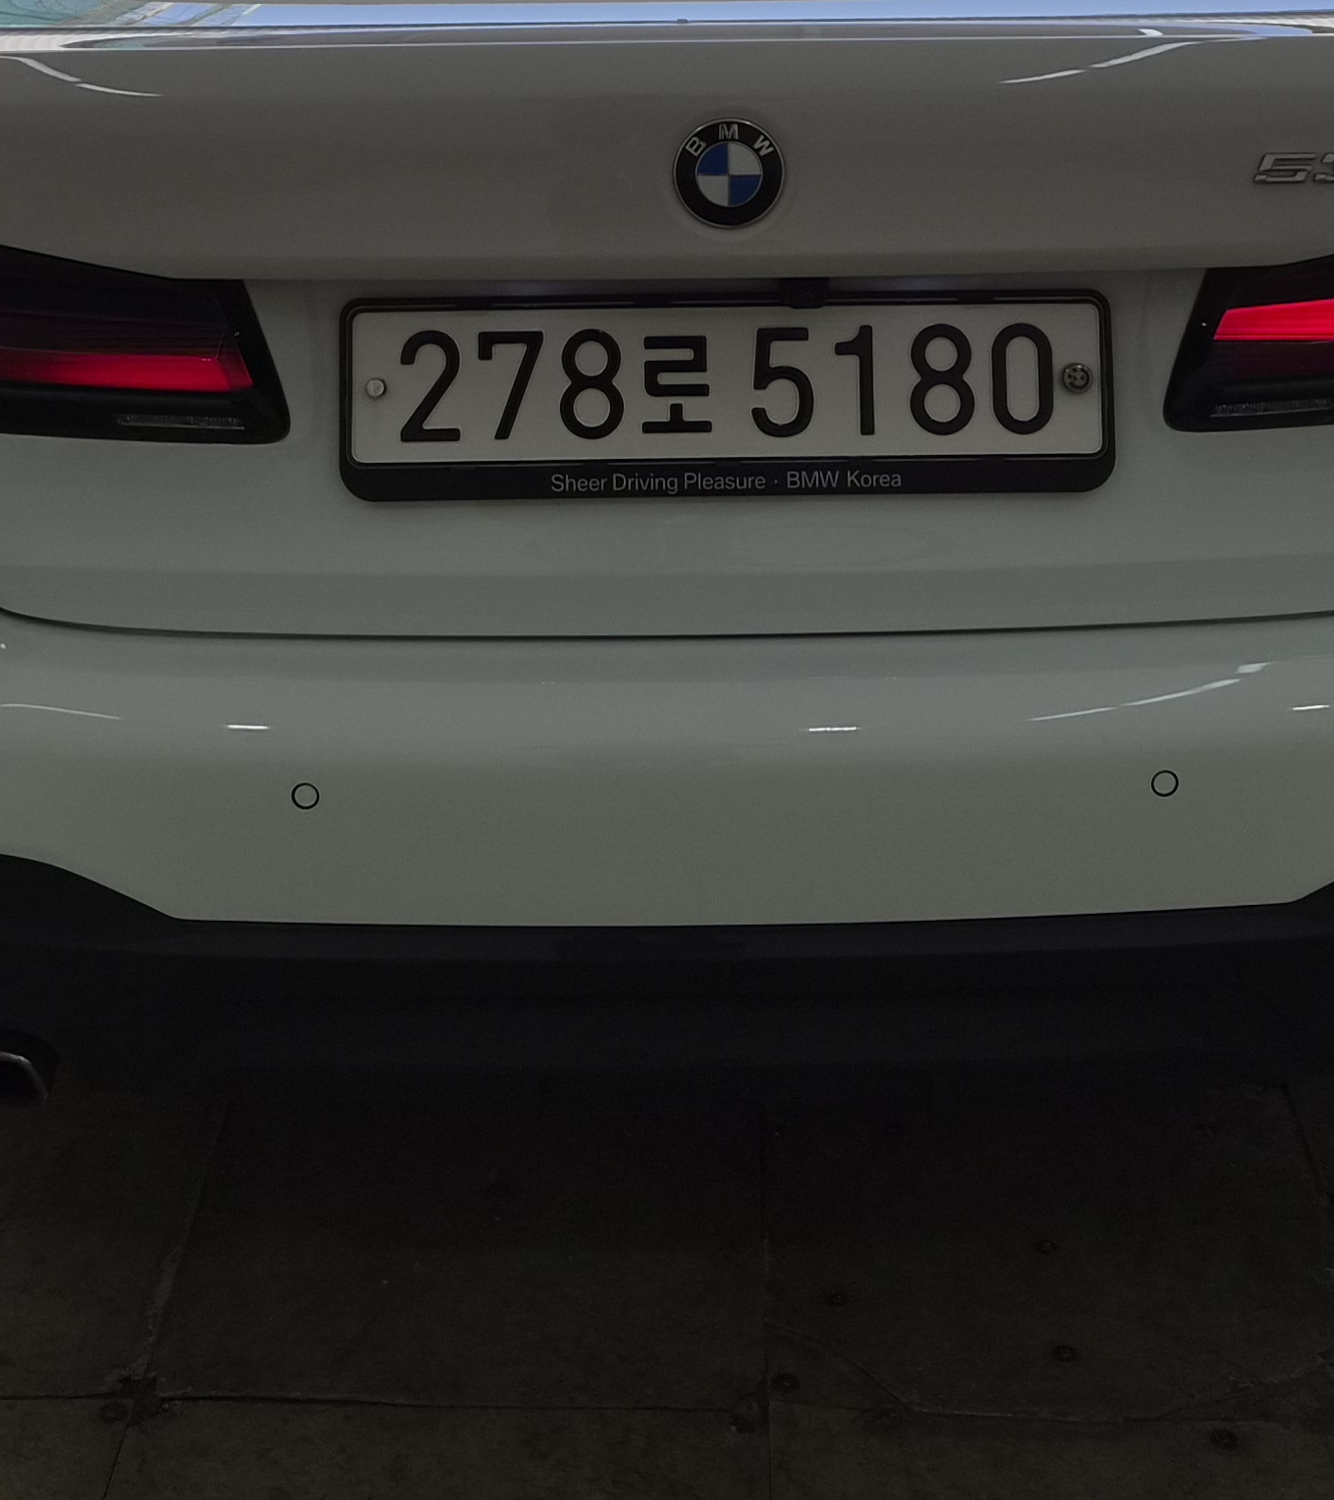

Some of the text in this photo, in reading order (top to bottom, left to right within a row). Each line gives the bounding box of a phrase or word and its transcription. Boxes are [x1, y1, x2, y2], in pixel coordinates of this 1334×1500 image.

[685, 123, 774, 157] BMW
[400, 322, 1055, 442] 278로 5180
[551, 474, 607, 492] Sheer
[612, 473, 678, 494] Driving
[684, 472, 766, 490] Pleasure
[787, 470, 839, 489] BMW
[847, 469, 902, 488] Korea
